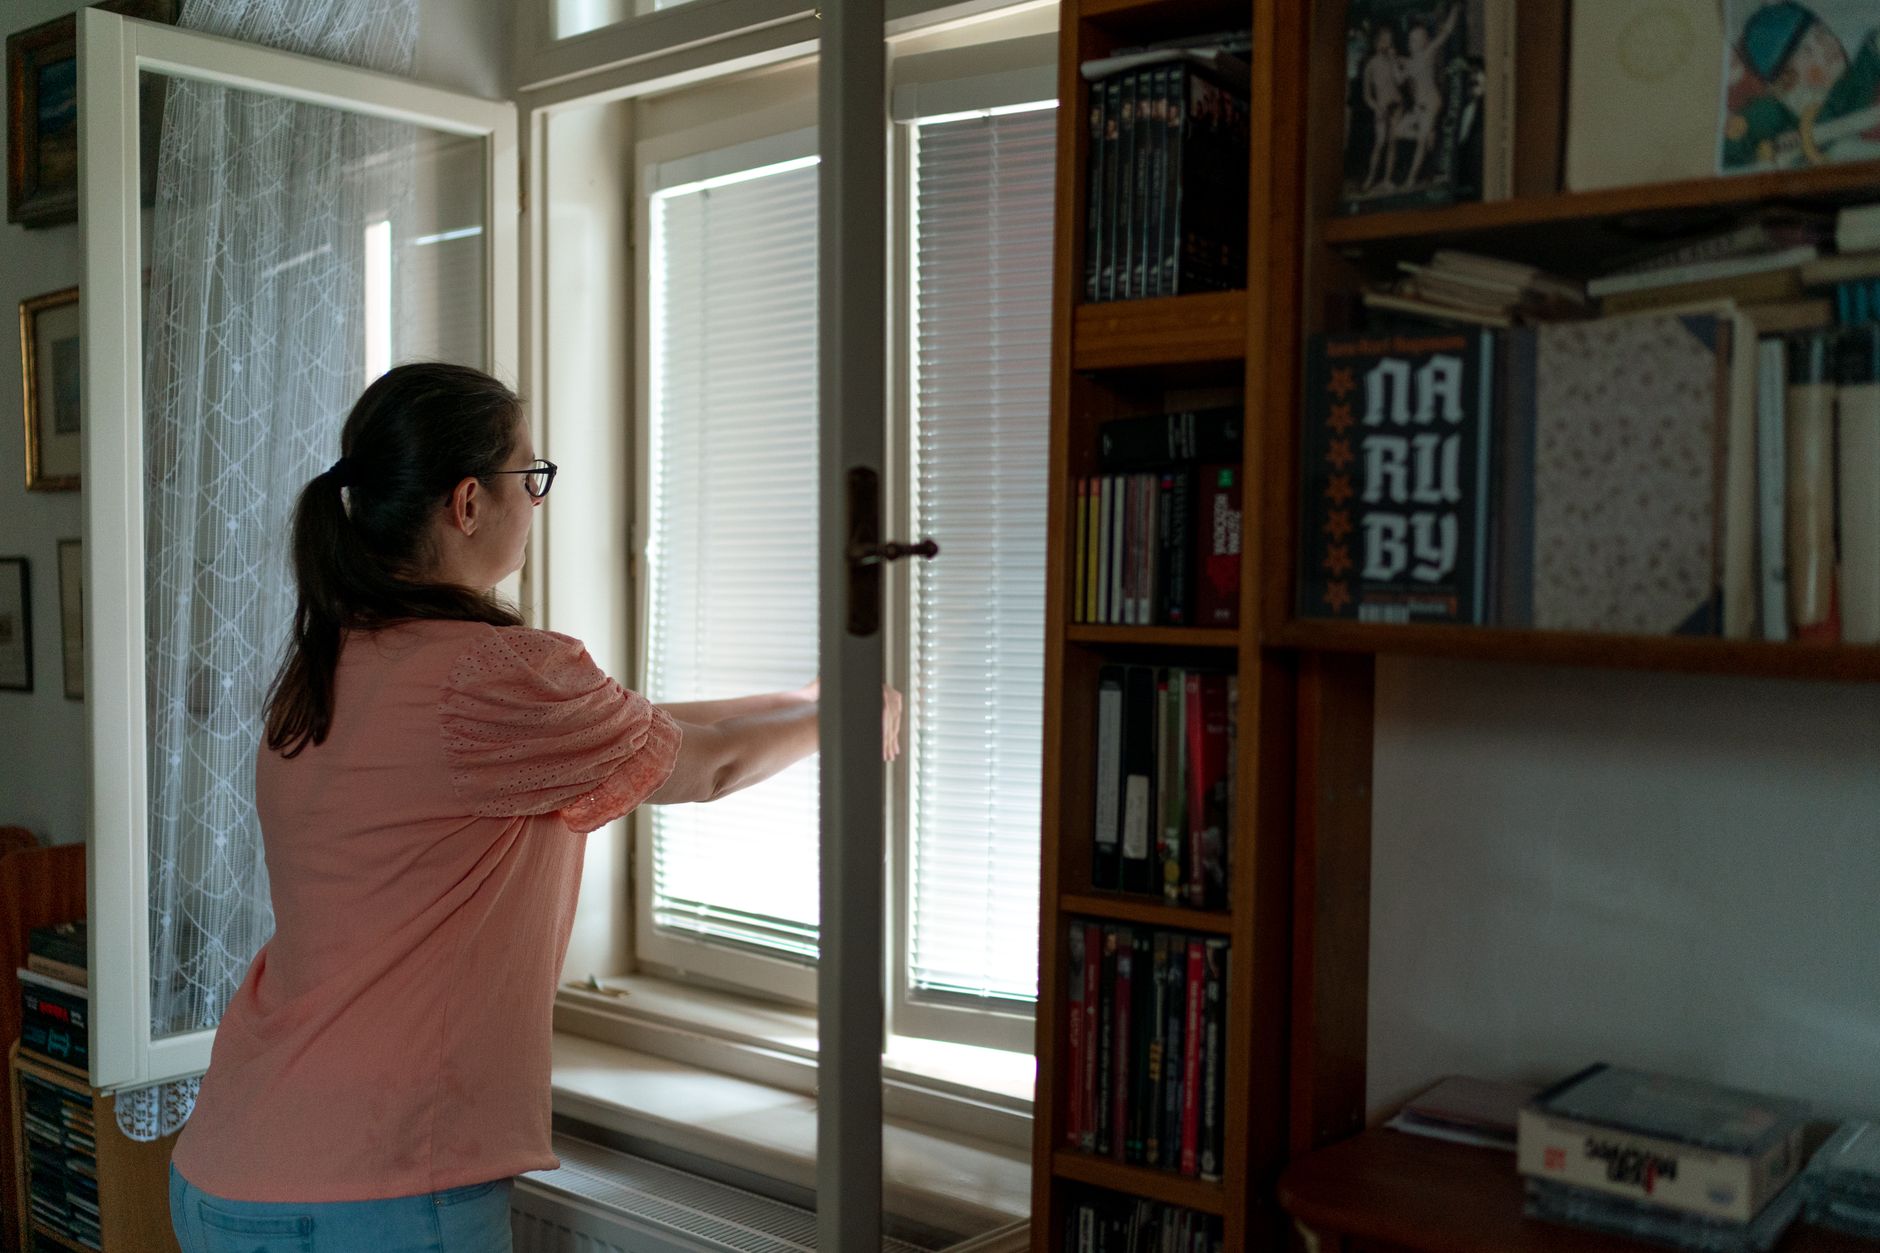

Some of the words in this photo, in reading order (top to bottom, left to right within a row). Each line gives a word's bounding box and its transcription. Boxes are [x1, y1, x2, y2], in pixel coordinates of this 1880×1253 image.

[1361, 352, 1466, 427] NA
[1360, 432, 1463, 505] RU
[1360, 510, 1460, 584] BY
